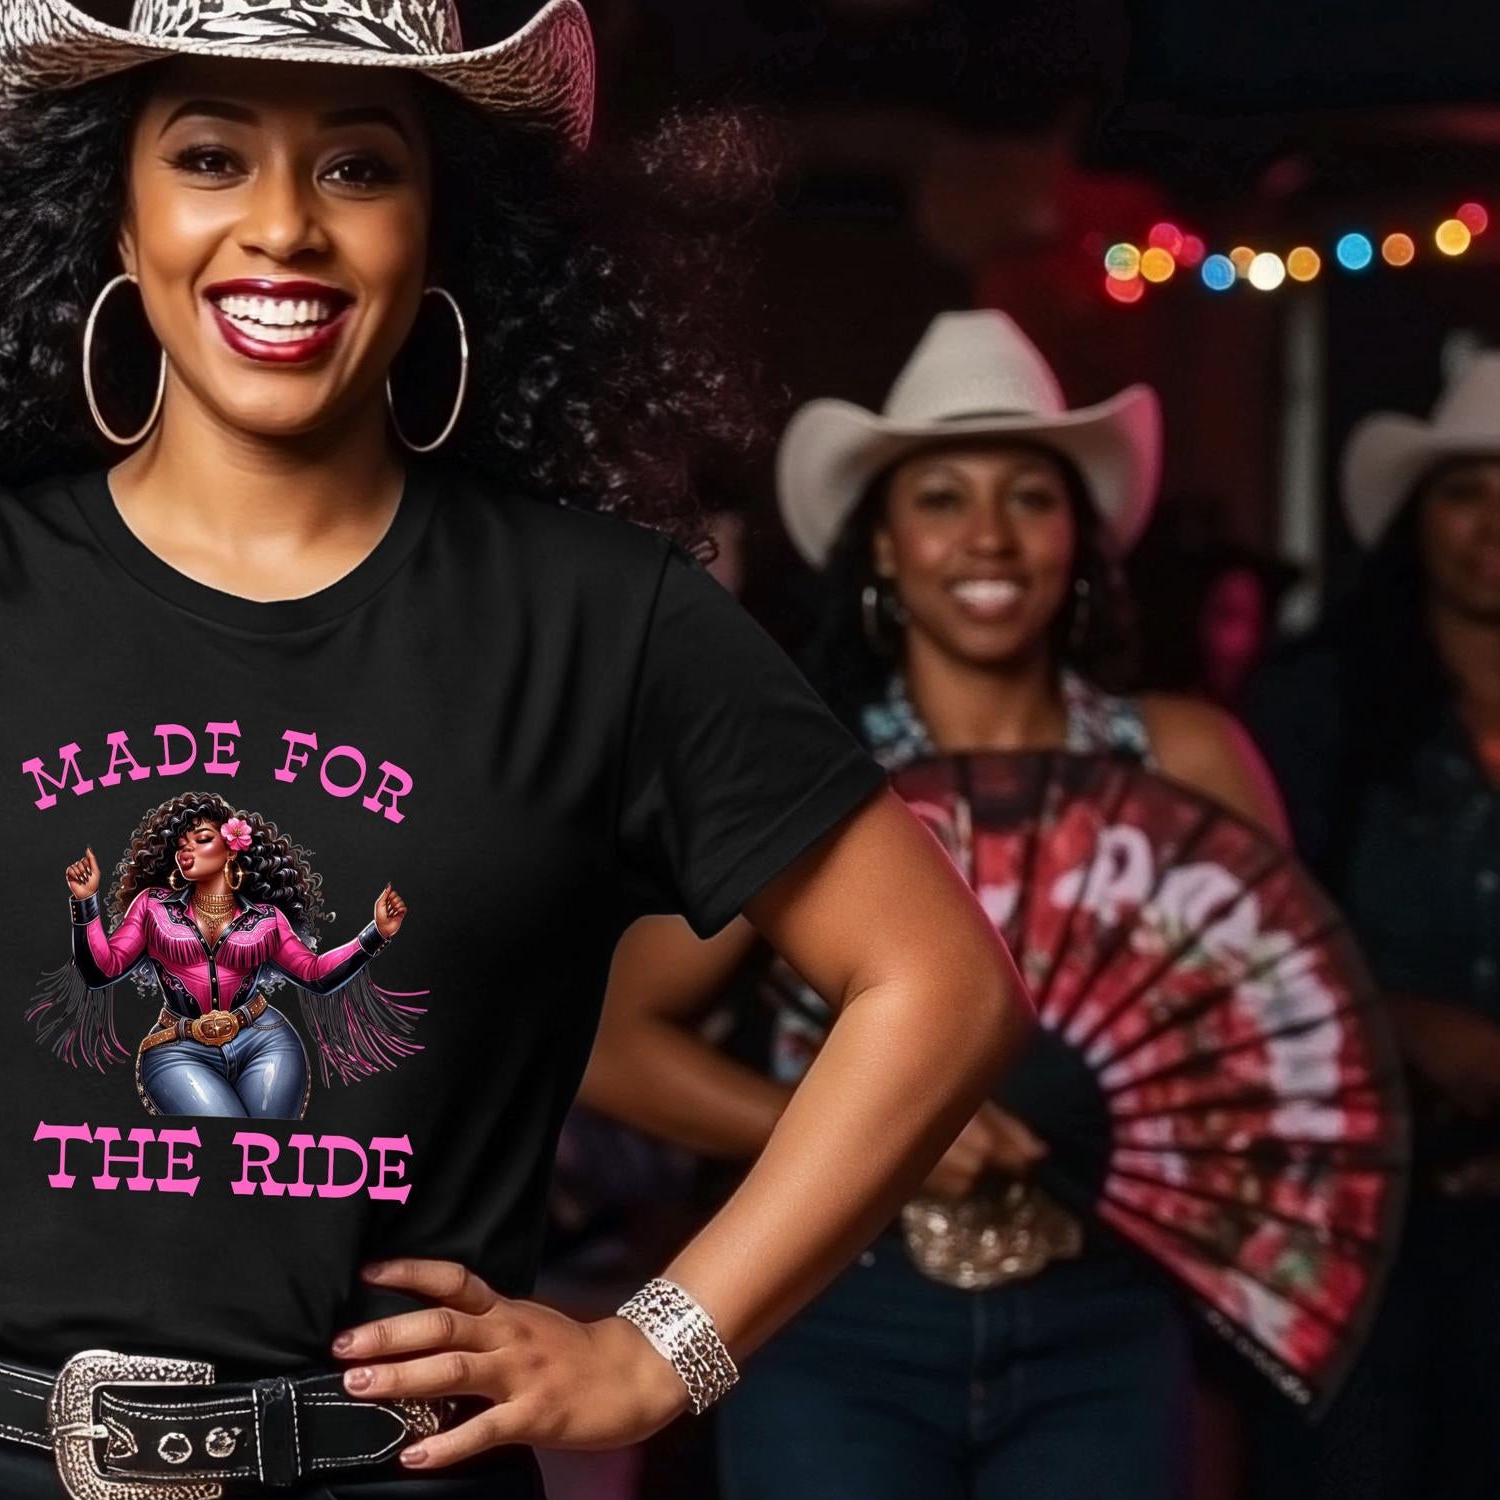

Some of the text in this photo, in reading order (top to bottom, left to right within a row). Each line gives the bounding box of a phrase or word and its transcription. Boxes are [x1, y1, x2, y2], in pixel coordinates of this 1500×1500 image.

[22, 720, 414, 824] MADE FOR
[33, 1121, 413, 1204] THE RIDE
